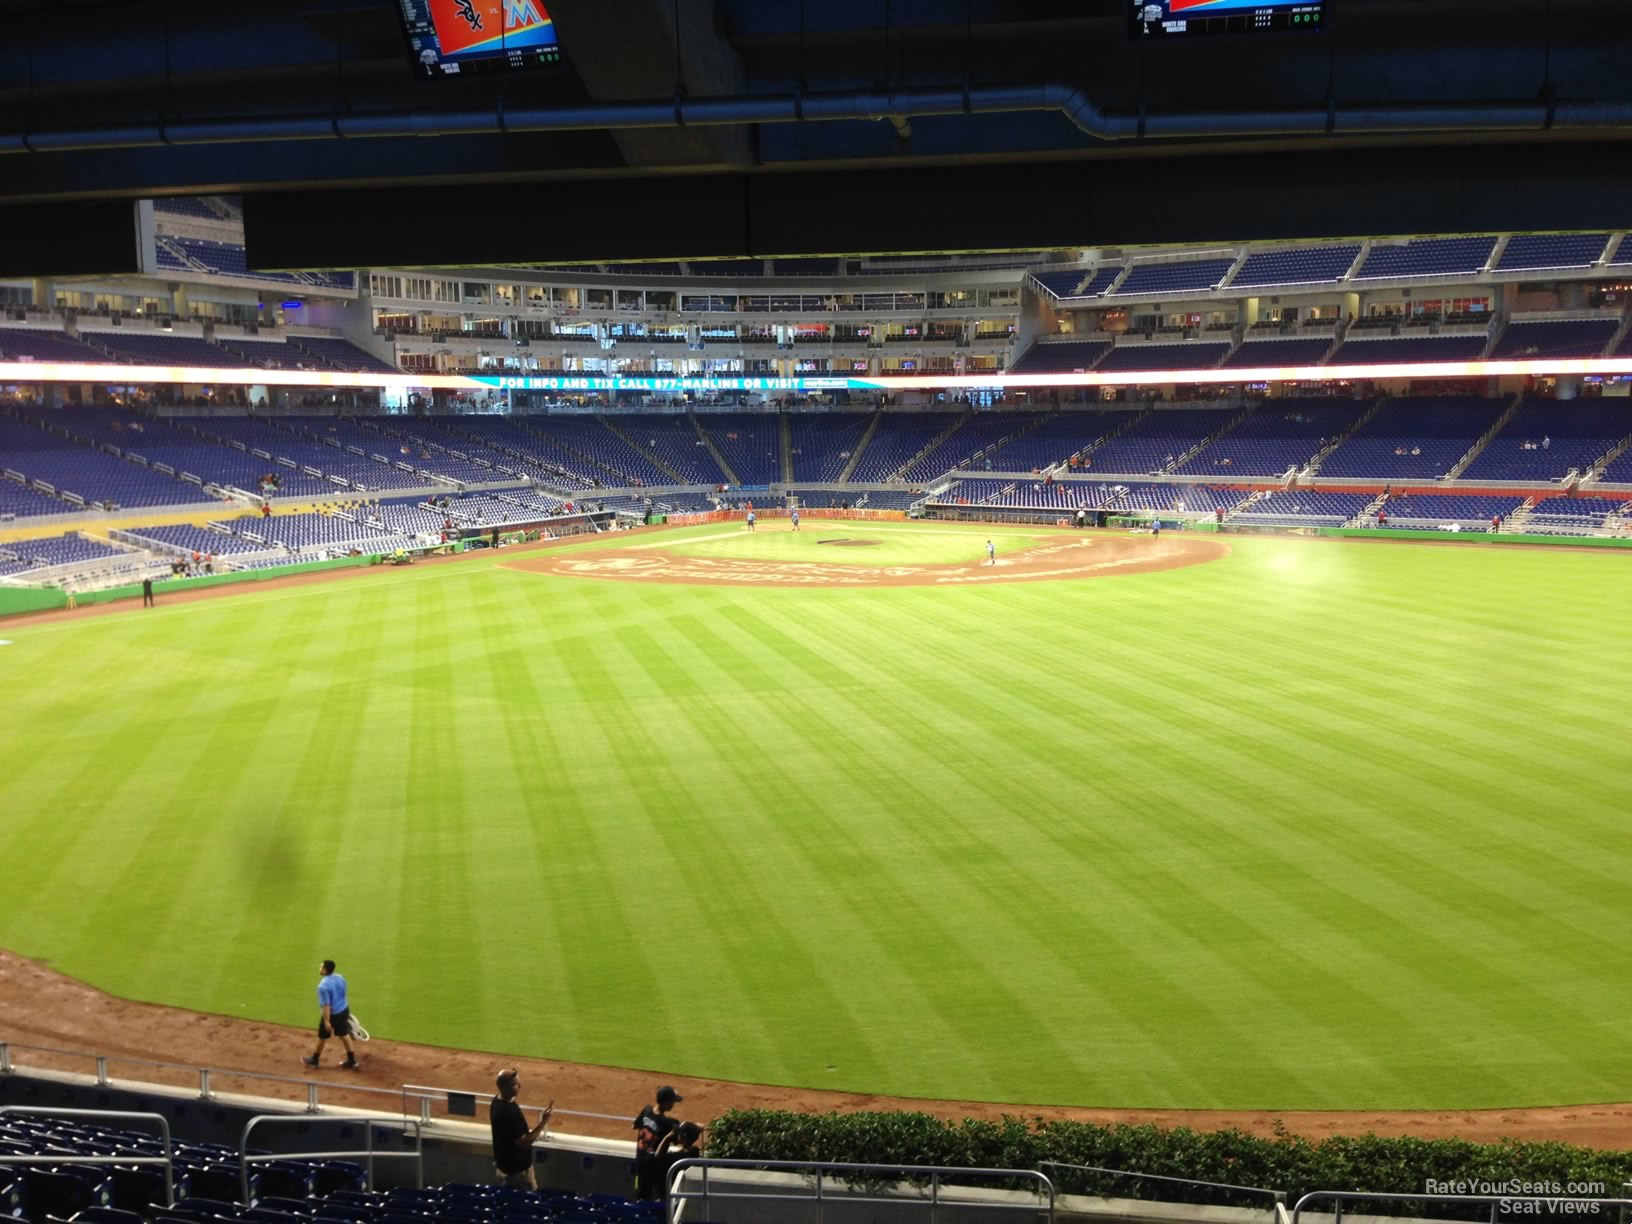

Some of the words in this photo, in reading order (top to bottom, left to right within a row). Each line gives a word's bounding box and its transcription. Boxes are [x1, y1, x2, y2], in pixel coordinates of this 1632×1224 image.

[500, 377, 525, 388] FOR
[529, 377, 559, 389] INFO
[562, 377, 589, 389] AND
[594, 378, 614, 389] TIX
[618, 378, 650, 389] CALL
[655, 378, 739, 389] 877-MARLINS
[743, 378, 761, 389] OR
[766, 379, 801, 389] VISIT
